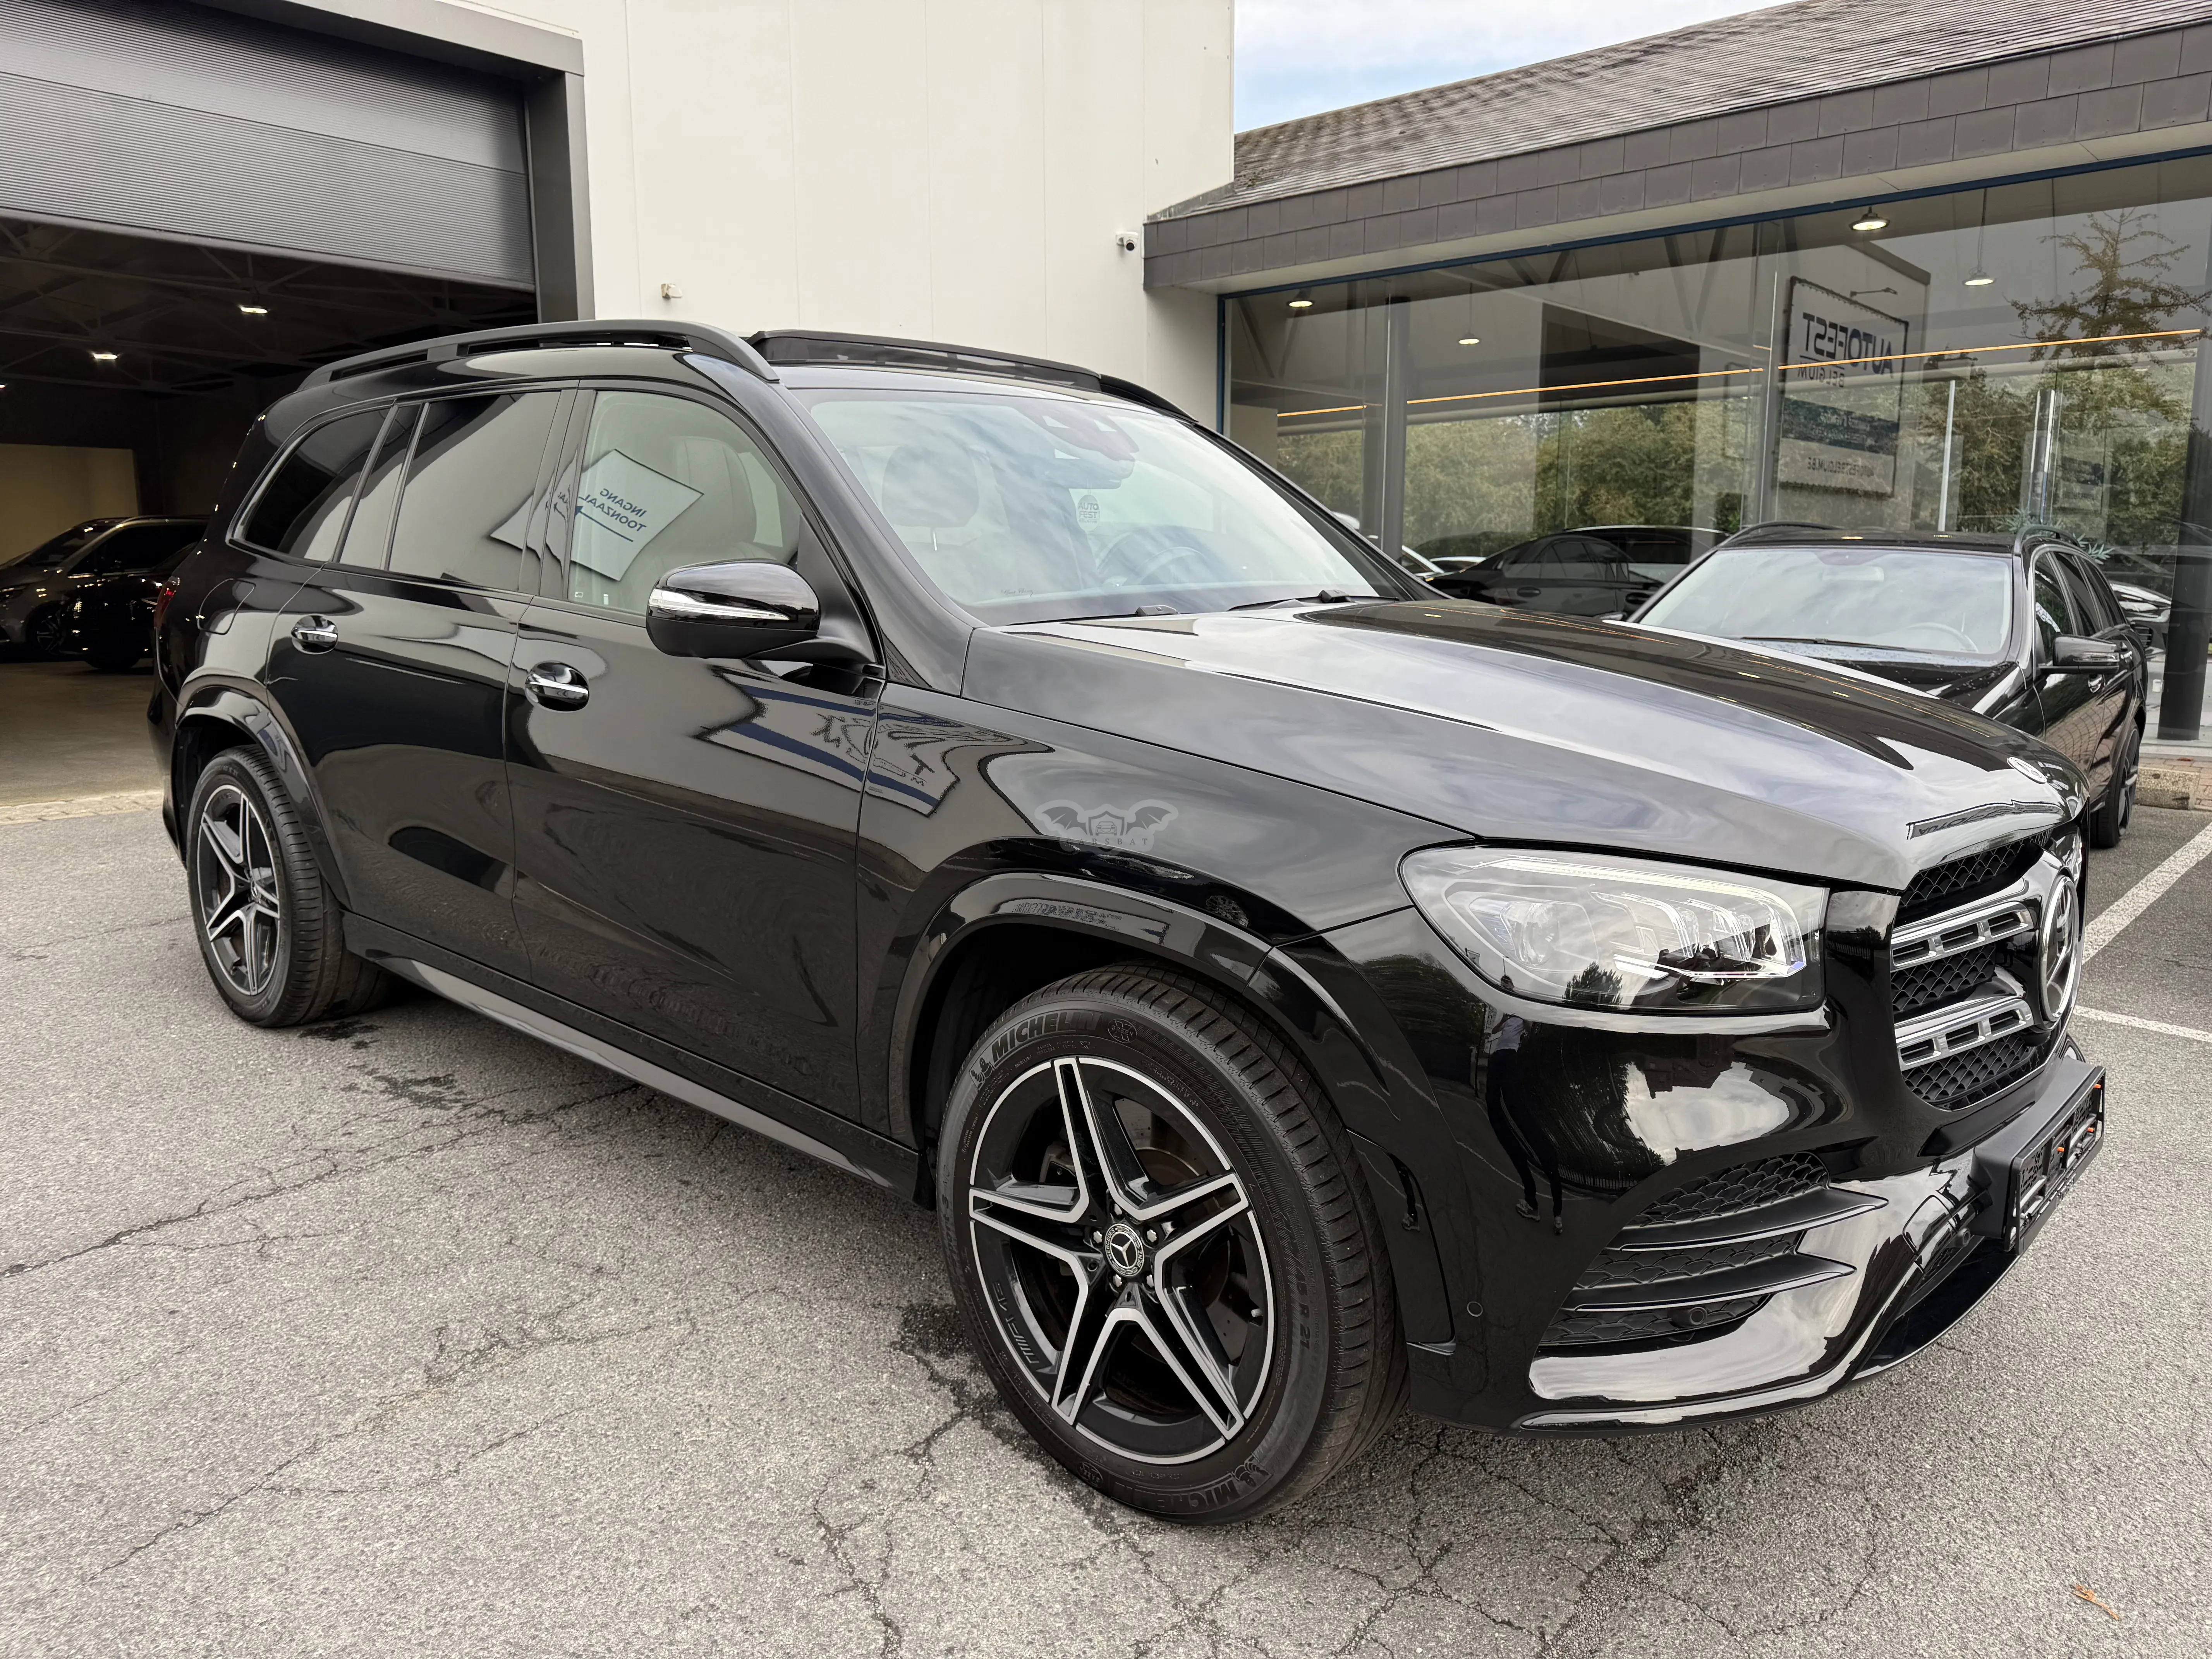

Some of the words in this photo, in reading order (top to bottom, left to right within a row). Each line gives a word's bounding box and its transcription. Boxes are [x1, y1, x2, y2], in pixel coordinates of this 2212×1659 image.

[991, 1011, 1102, 1063] MICHELIN
[1105, 1228, 1115, 1260] MERCEDES
[1300, 1323, 1310, 1350] 21
